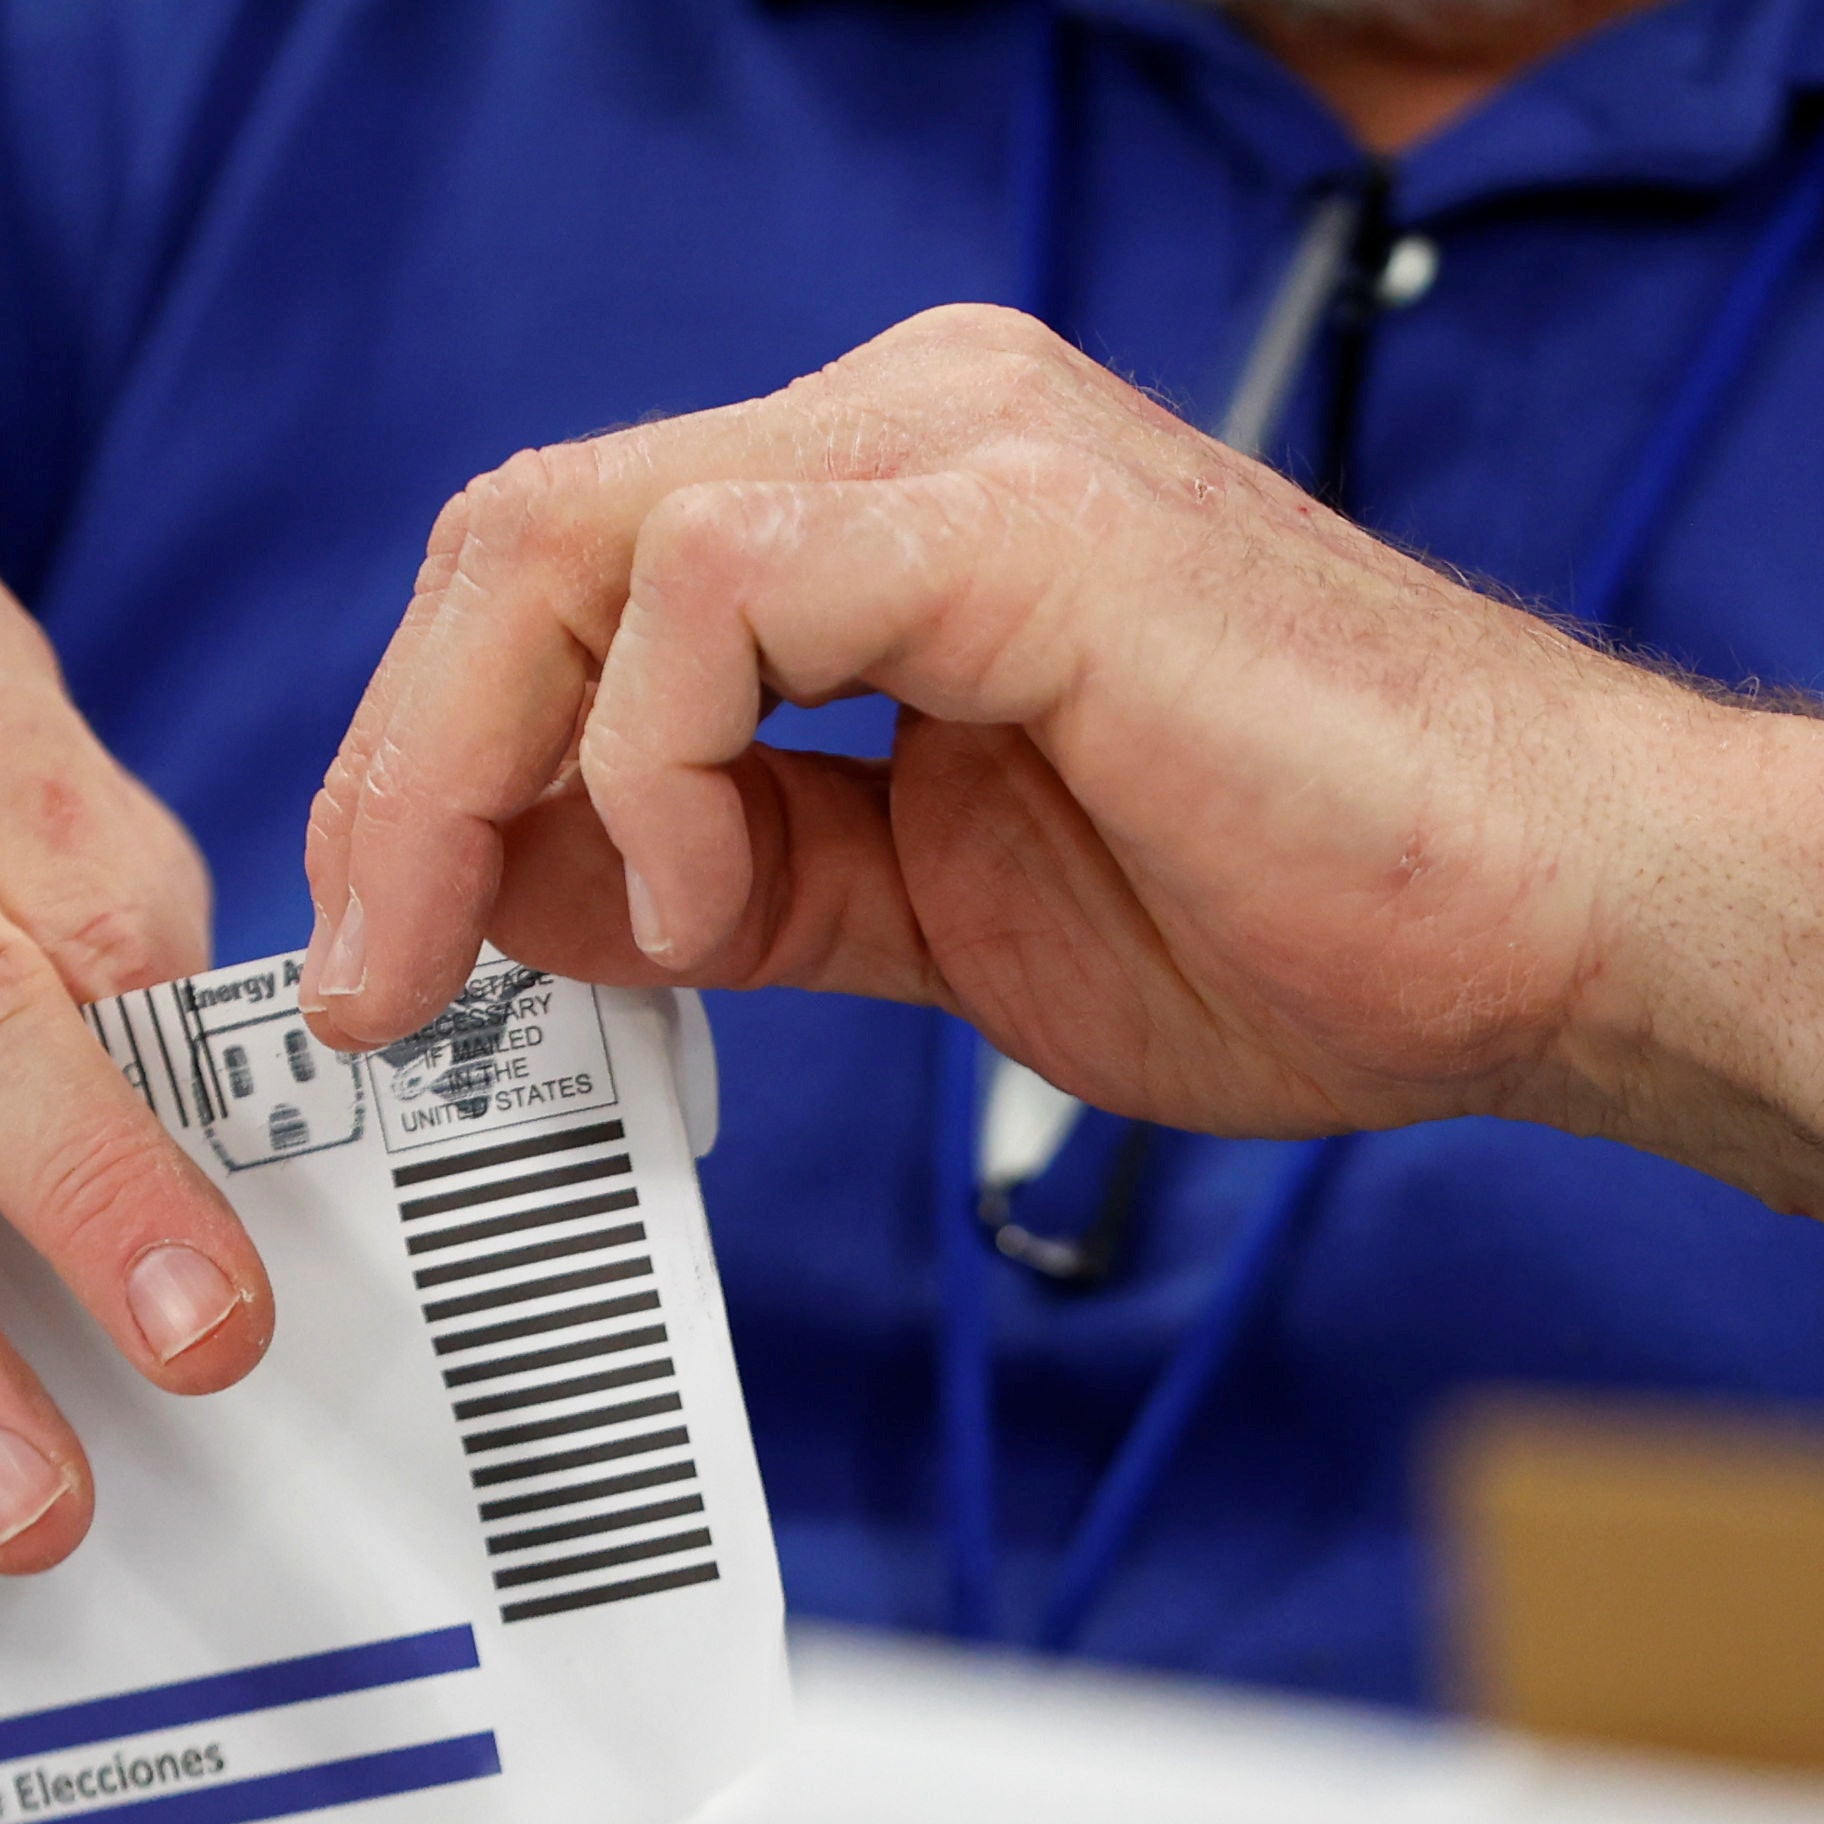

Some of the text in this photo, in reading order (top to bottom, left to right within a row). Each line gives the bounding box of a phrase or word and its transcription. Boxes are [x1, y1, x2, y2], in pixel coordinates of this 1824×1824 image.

[426, 1046, 443, 1069] IF
[449, 1057, 530, 1092] IN THE
[401, 1073, 593, 1132] UNITED STATES
[14, 1741, 226, 1812] Elecciones
